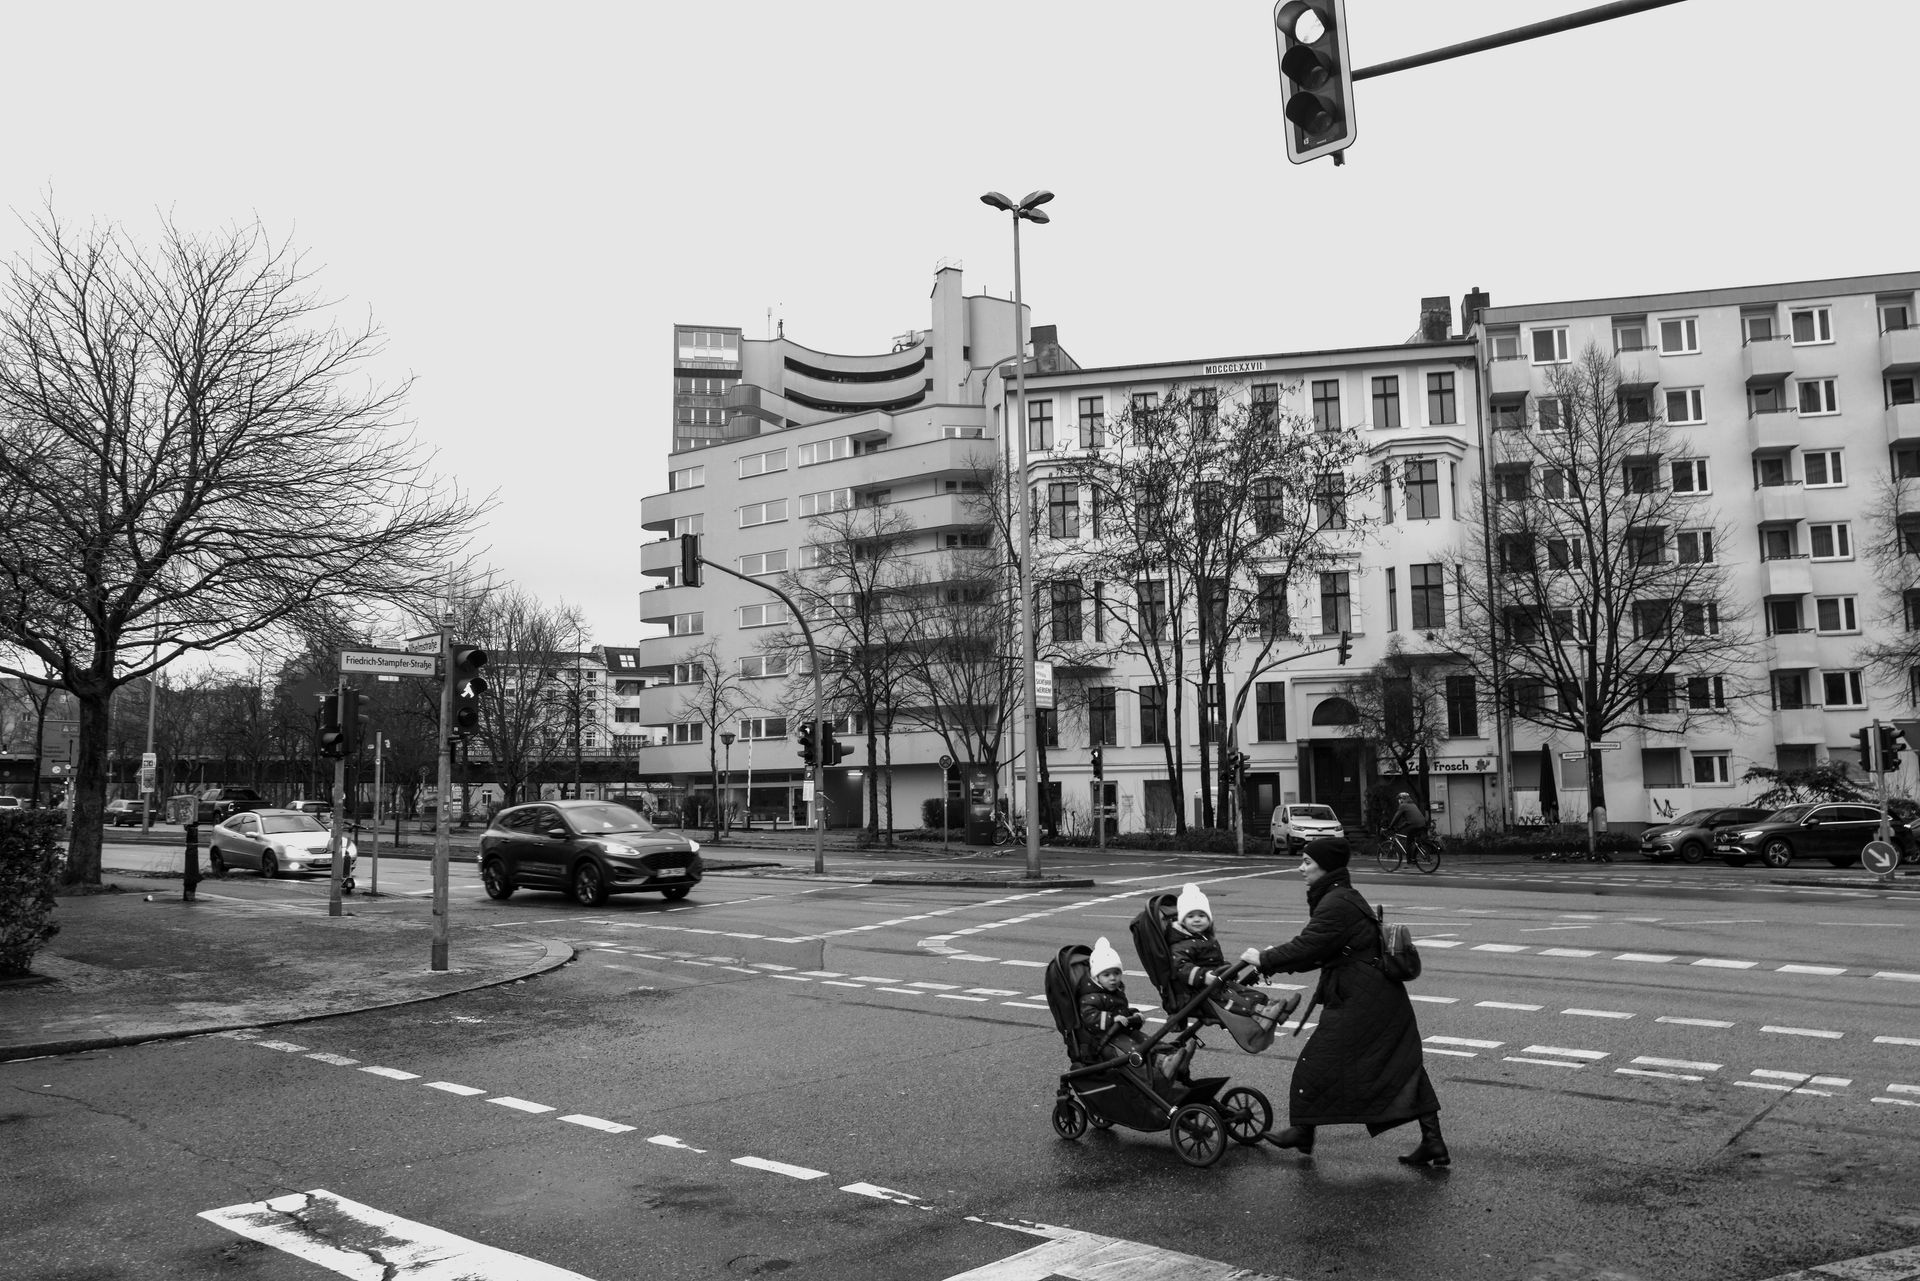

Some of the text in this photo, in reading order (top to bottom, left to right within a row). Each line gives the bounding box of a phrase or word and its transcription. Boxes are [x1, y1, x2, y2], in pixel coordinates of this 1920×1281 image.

[1206, 362, 1262, 374] MDCCCLXXVII
[346, 656, 432, 670] Friedrich-Stampfer-Straße
[1433, 760, 1469, 772] Frosch
